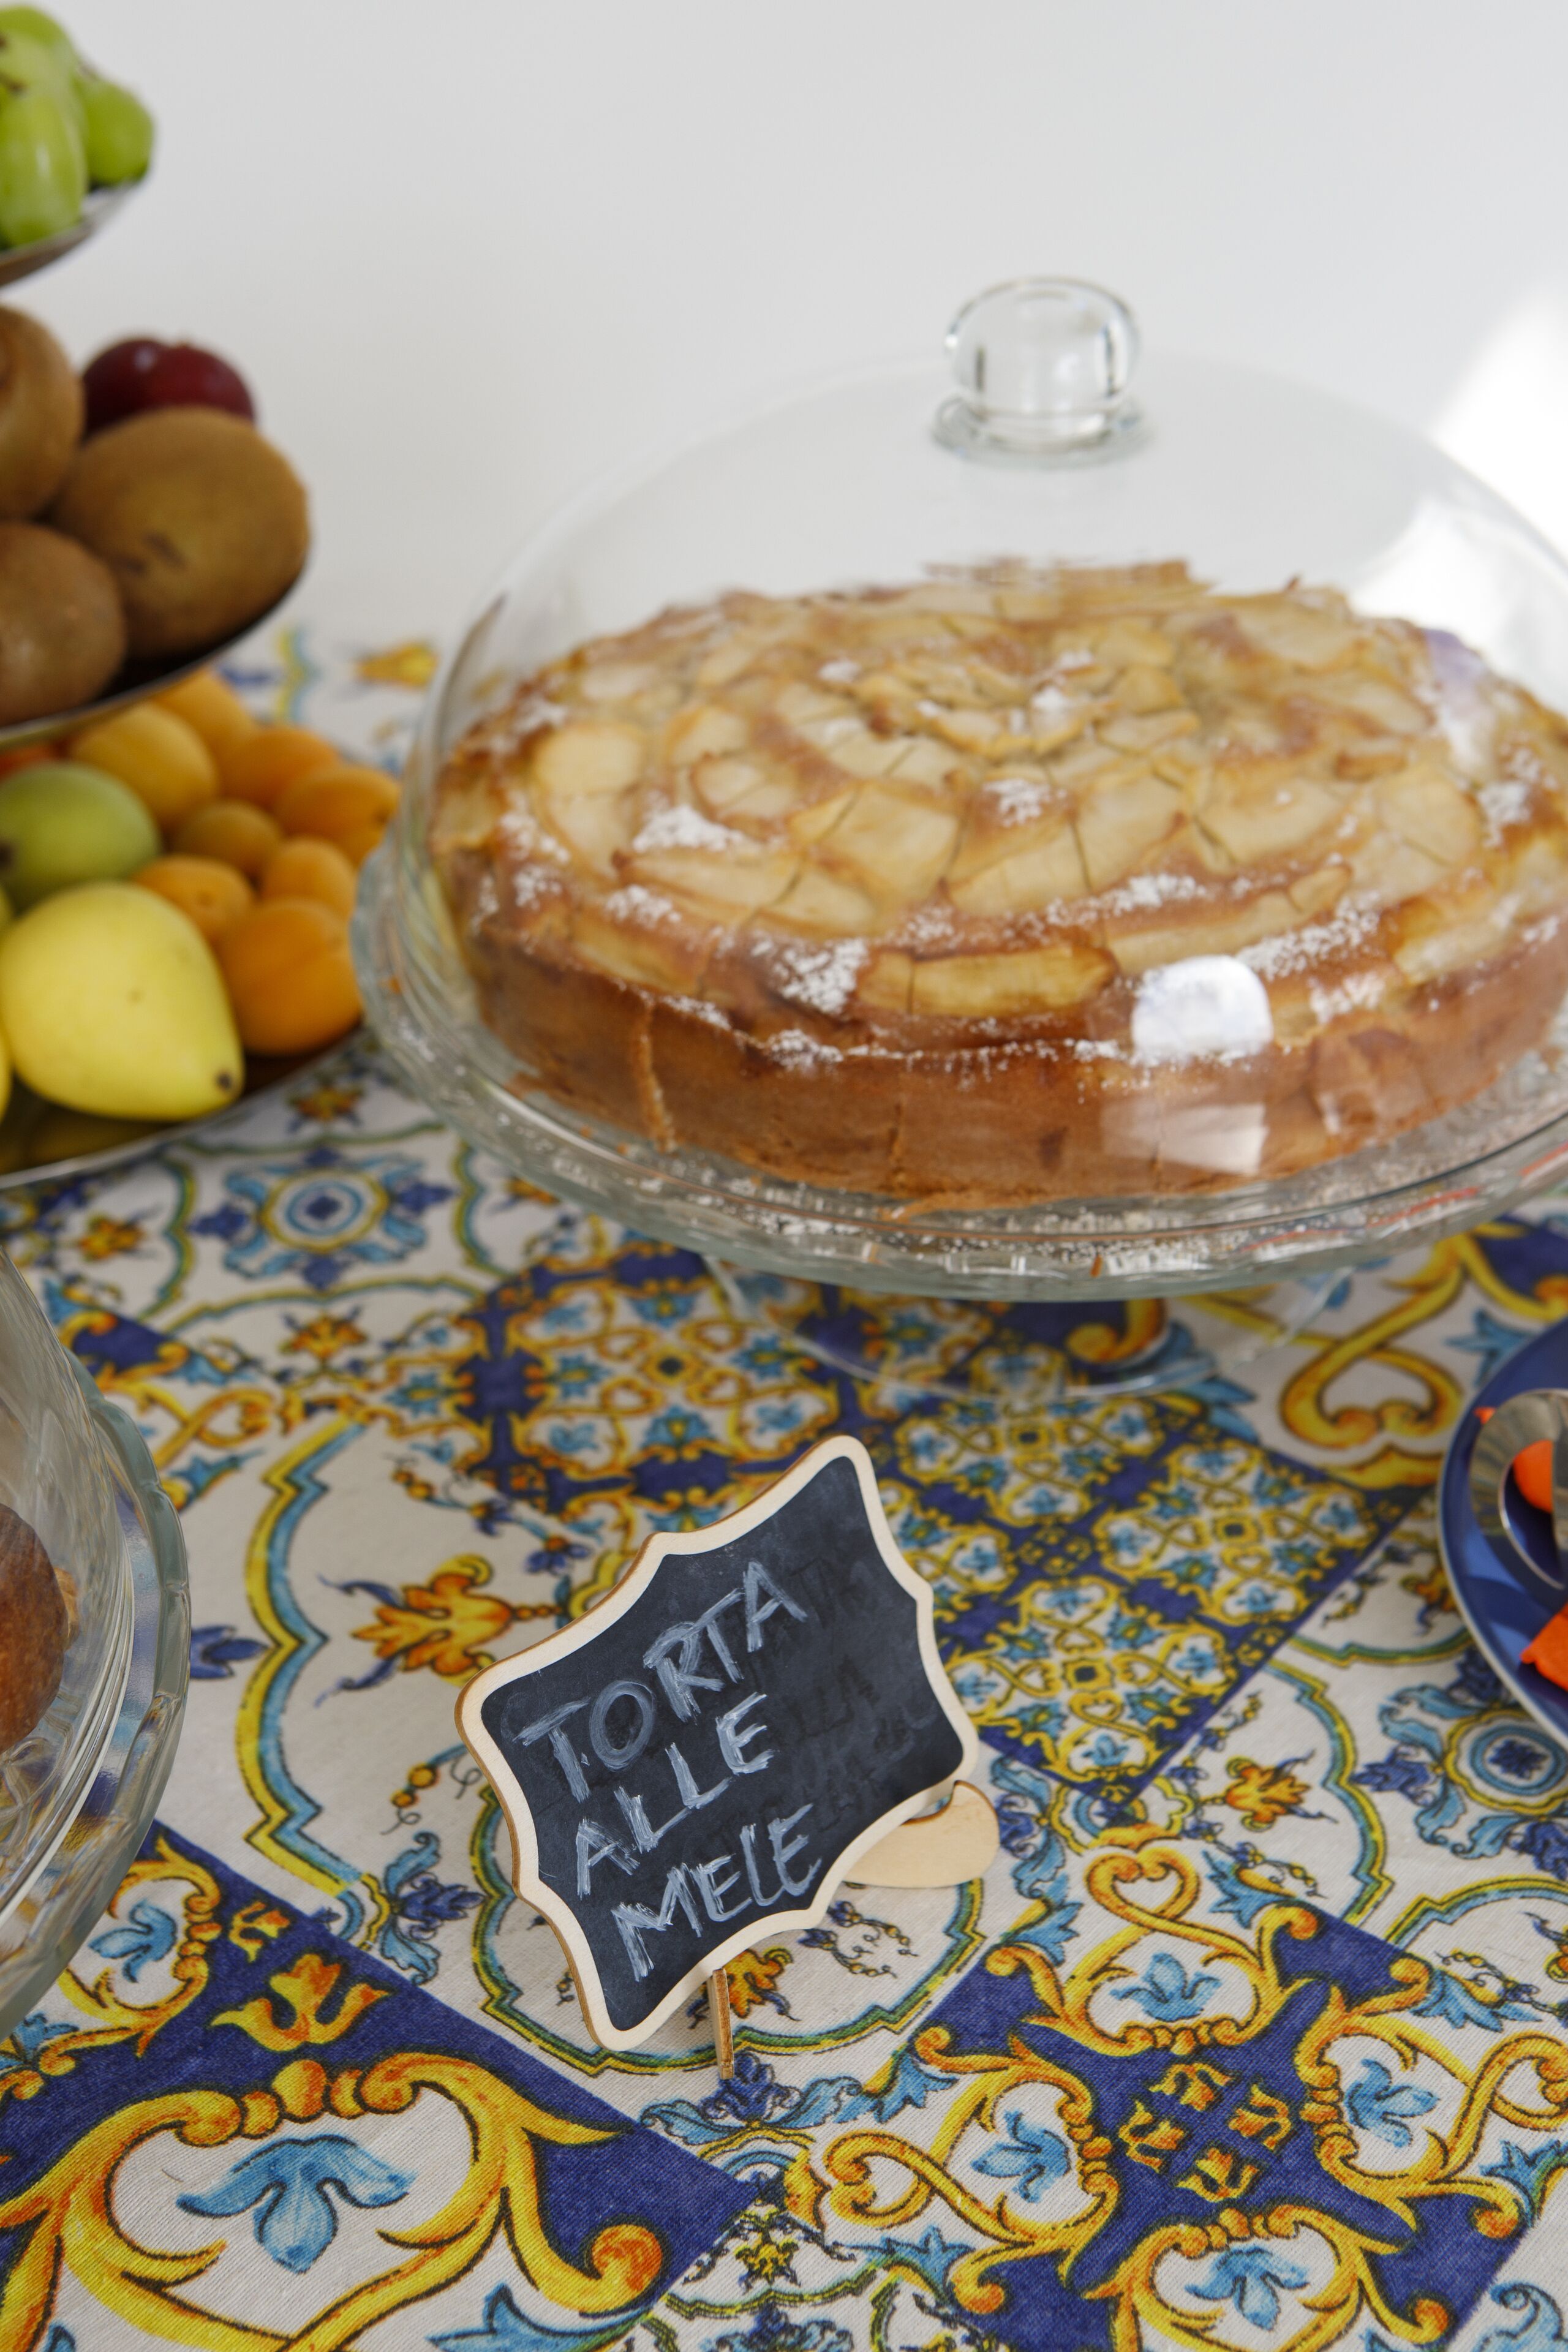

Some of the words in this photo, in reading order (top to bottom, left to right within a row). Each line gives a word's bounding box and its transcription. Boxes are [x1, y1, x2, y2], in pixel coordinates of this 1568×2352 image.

[514, 1561, 807, 1801] TORTA
[577, 1692, 773, 1897] ALLE
[612, 1804, 822, 1980] MELE
